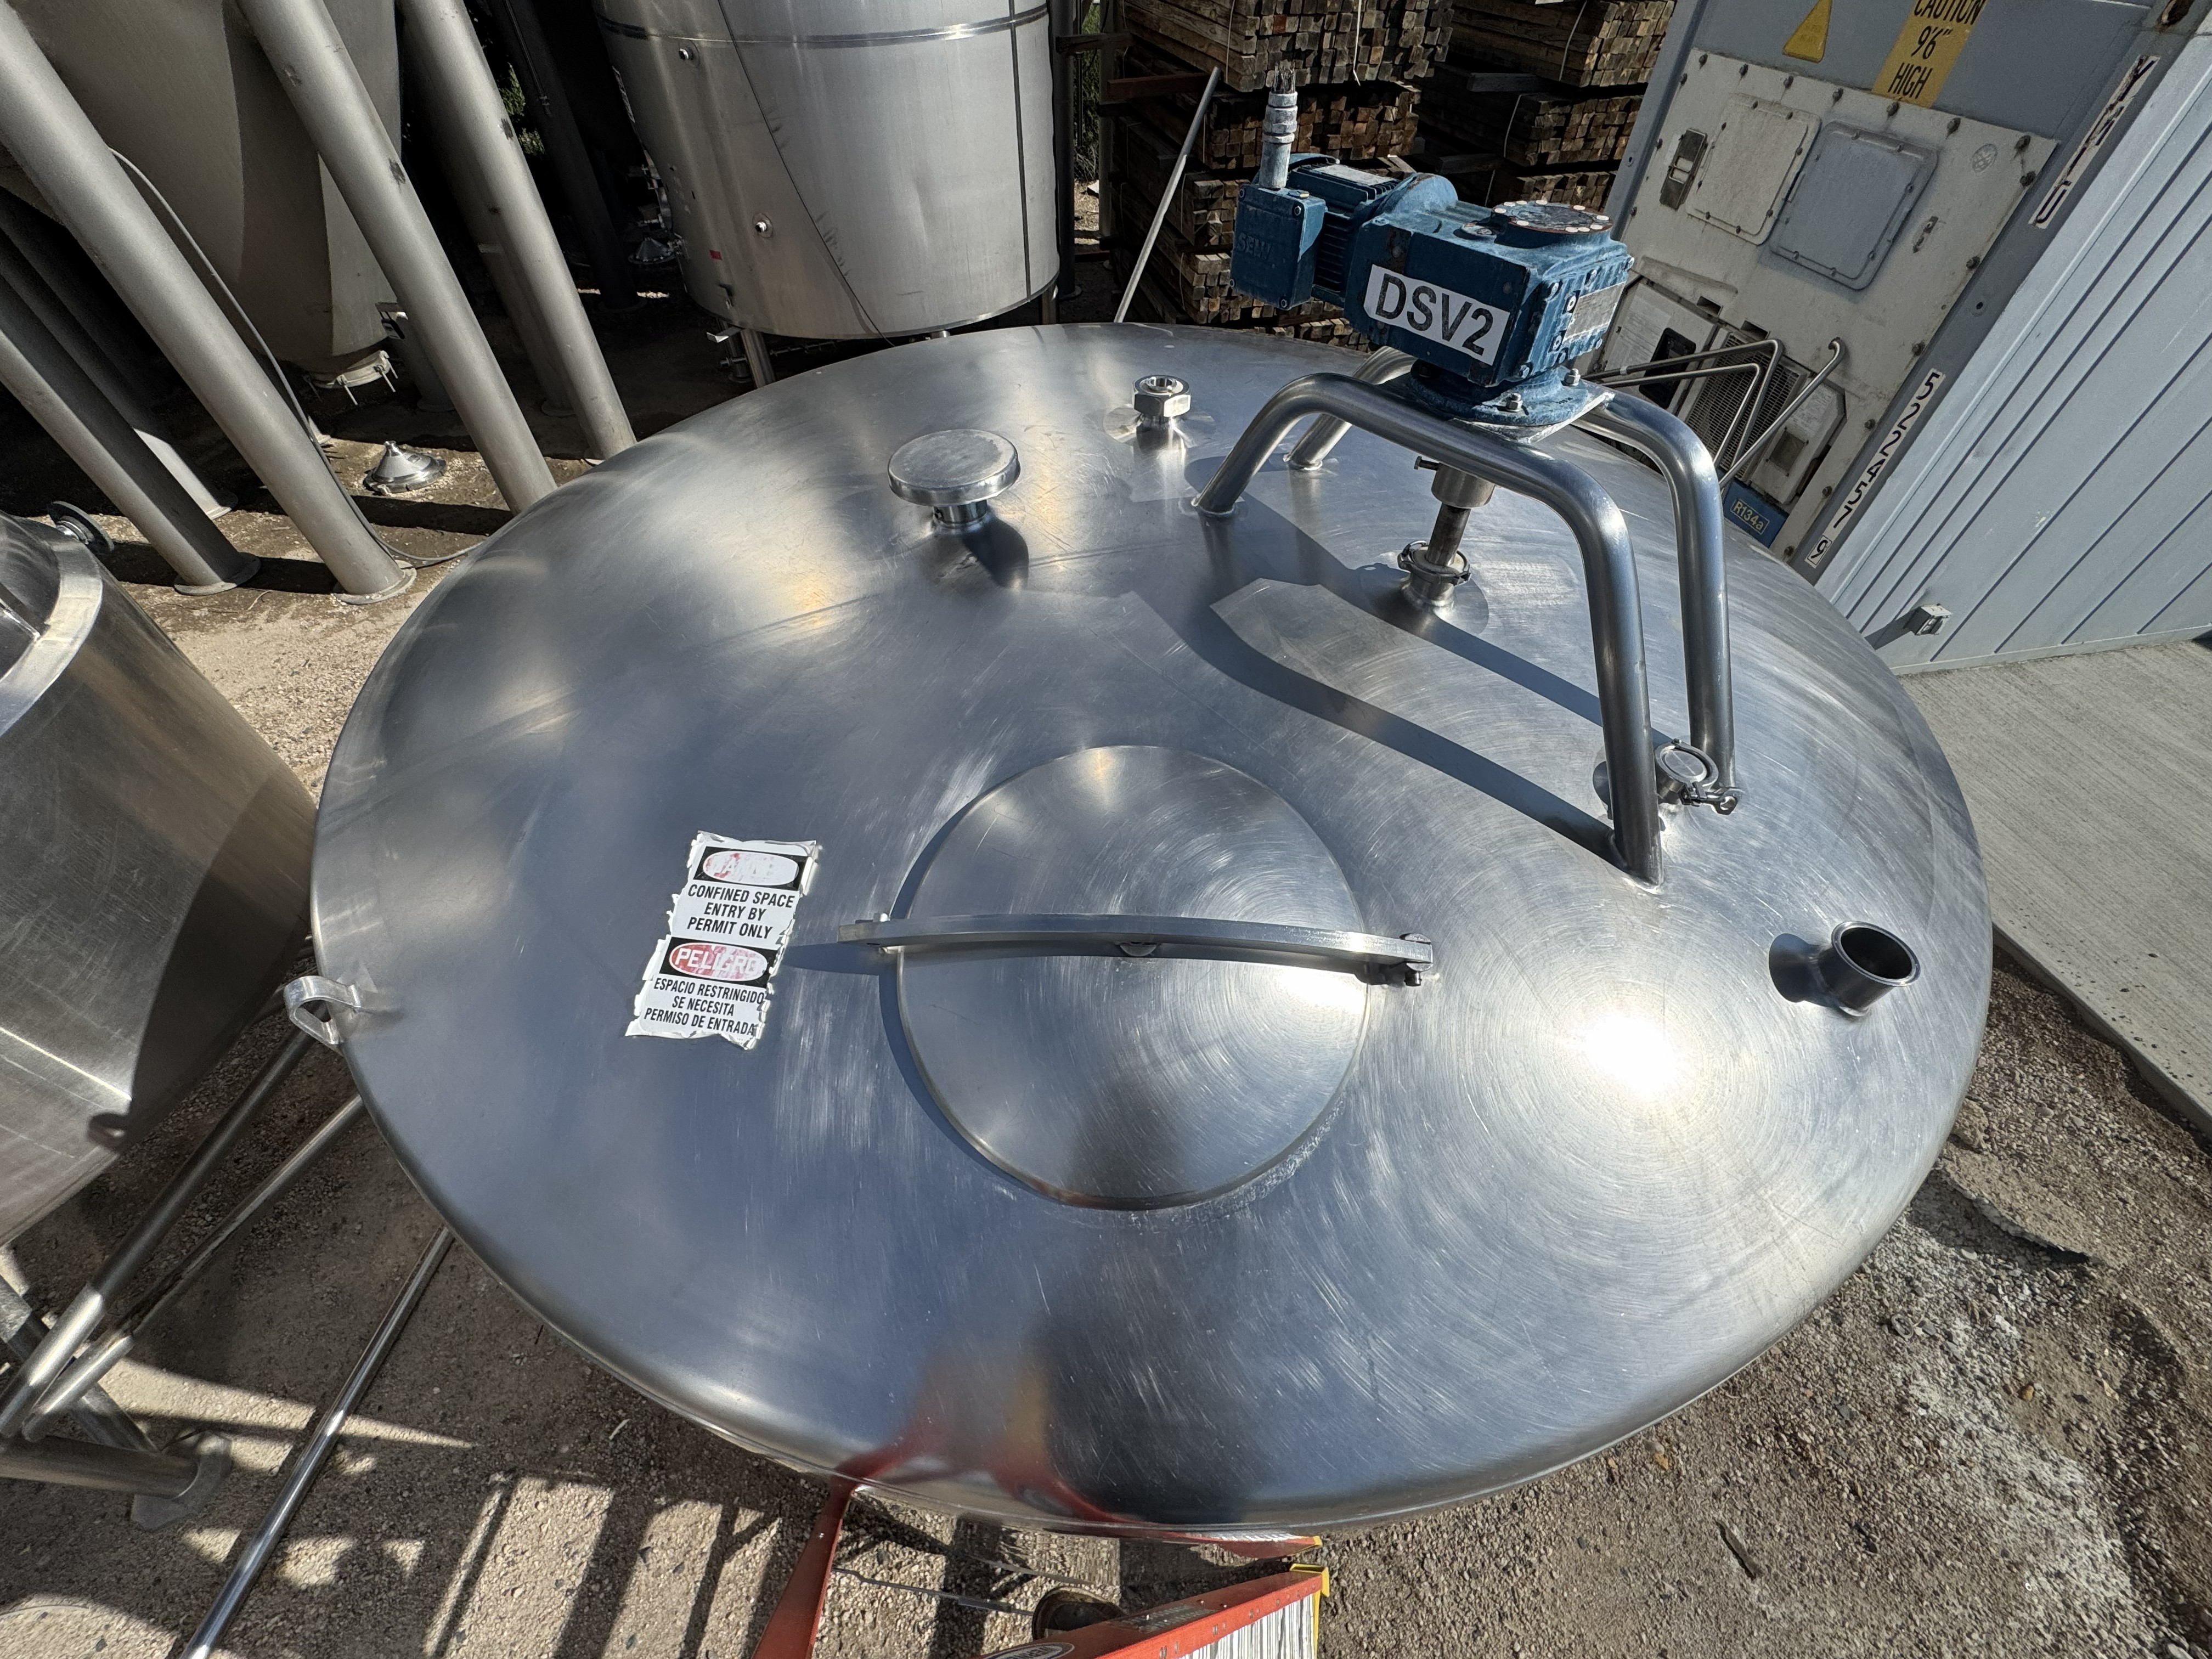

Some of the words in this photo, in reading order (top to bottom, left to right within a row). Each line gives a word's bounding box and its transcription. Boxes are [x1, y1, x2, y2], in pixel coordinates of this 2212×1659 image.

[1888, 63, 1933, 99] HIGH
[1375, 273, 1493, 356] DSV2
[1734, 500, 1764, 531] R134a
[688, 884, 750, 902] CONFINED
[752, 891, 795, 908] SPACE
[703, 902, 746, 918] ENTRY
[747, 907, 767, 921] BY
[687, 916, 737, 934] PERMIT
[739, 923, 774, 939] ONLY
[675, 947, 759, 975] PELIGRO
[653, 977, 695, 994] ESPACIO
[697, 984, 765, 1005] RESTRINGIDO
[672, 996, 686, 1008] SE
[687, 997, 735, 1016] NECESITA
[644, 1007, 690, 1025] PERMISO
[691, 1014, 706, 1028] DE
[707, 1017, 755, 1036] ENTRADA
